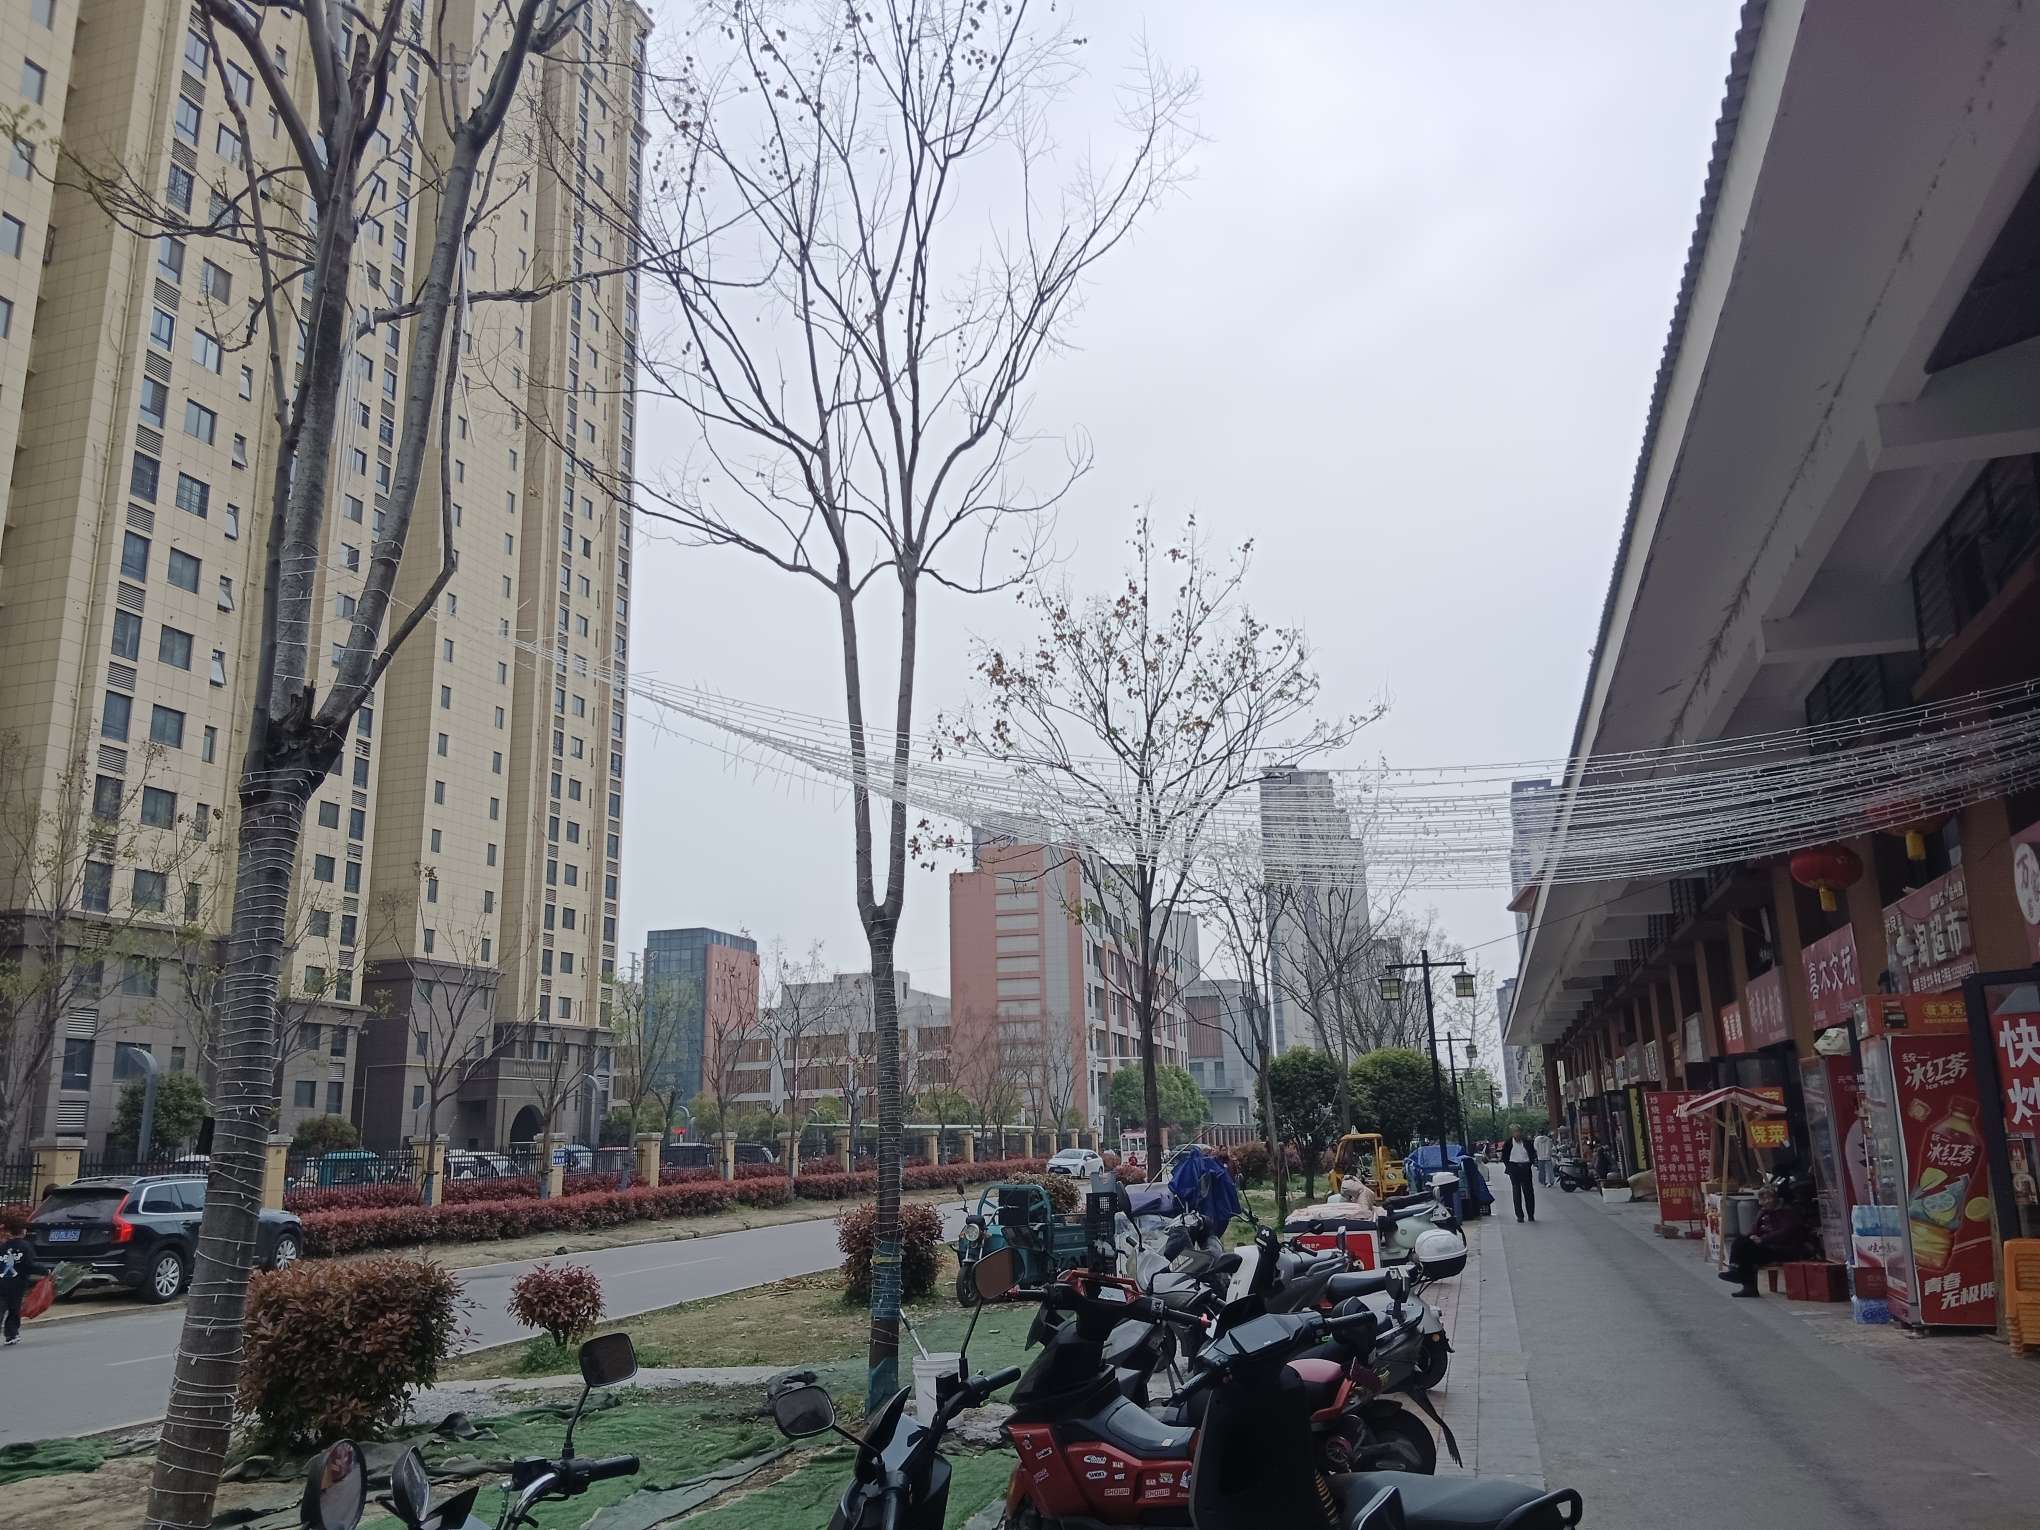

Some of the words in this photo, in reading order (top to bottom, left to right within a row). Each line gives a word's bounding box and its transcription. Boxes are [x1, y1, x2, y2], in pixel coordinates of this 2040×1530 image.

[1904, 1051, 1970, 1090] 冰红茶
[1750, 1125, 1785, 1144] 烧菜
[1927, 1142, 1977, 1166] 冰红茶
[1924, 1272, 1961, 1296] 青春
[1940, 1281, 1997, 1310] 无极限
